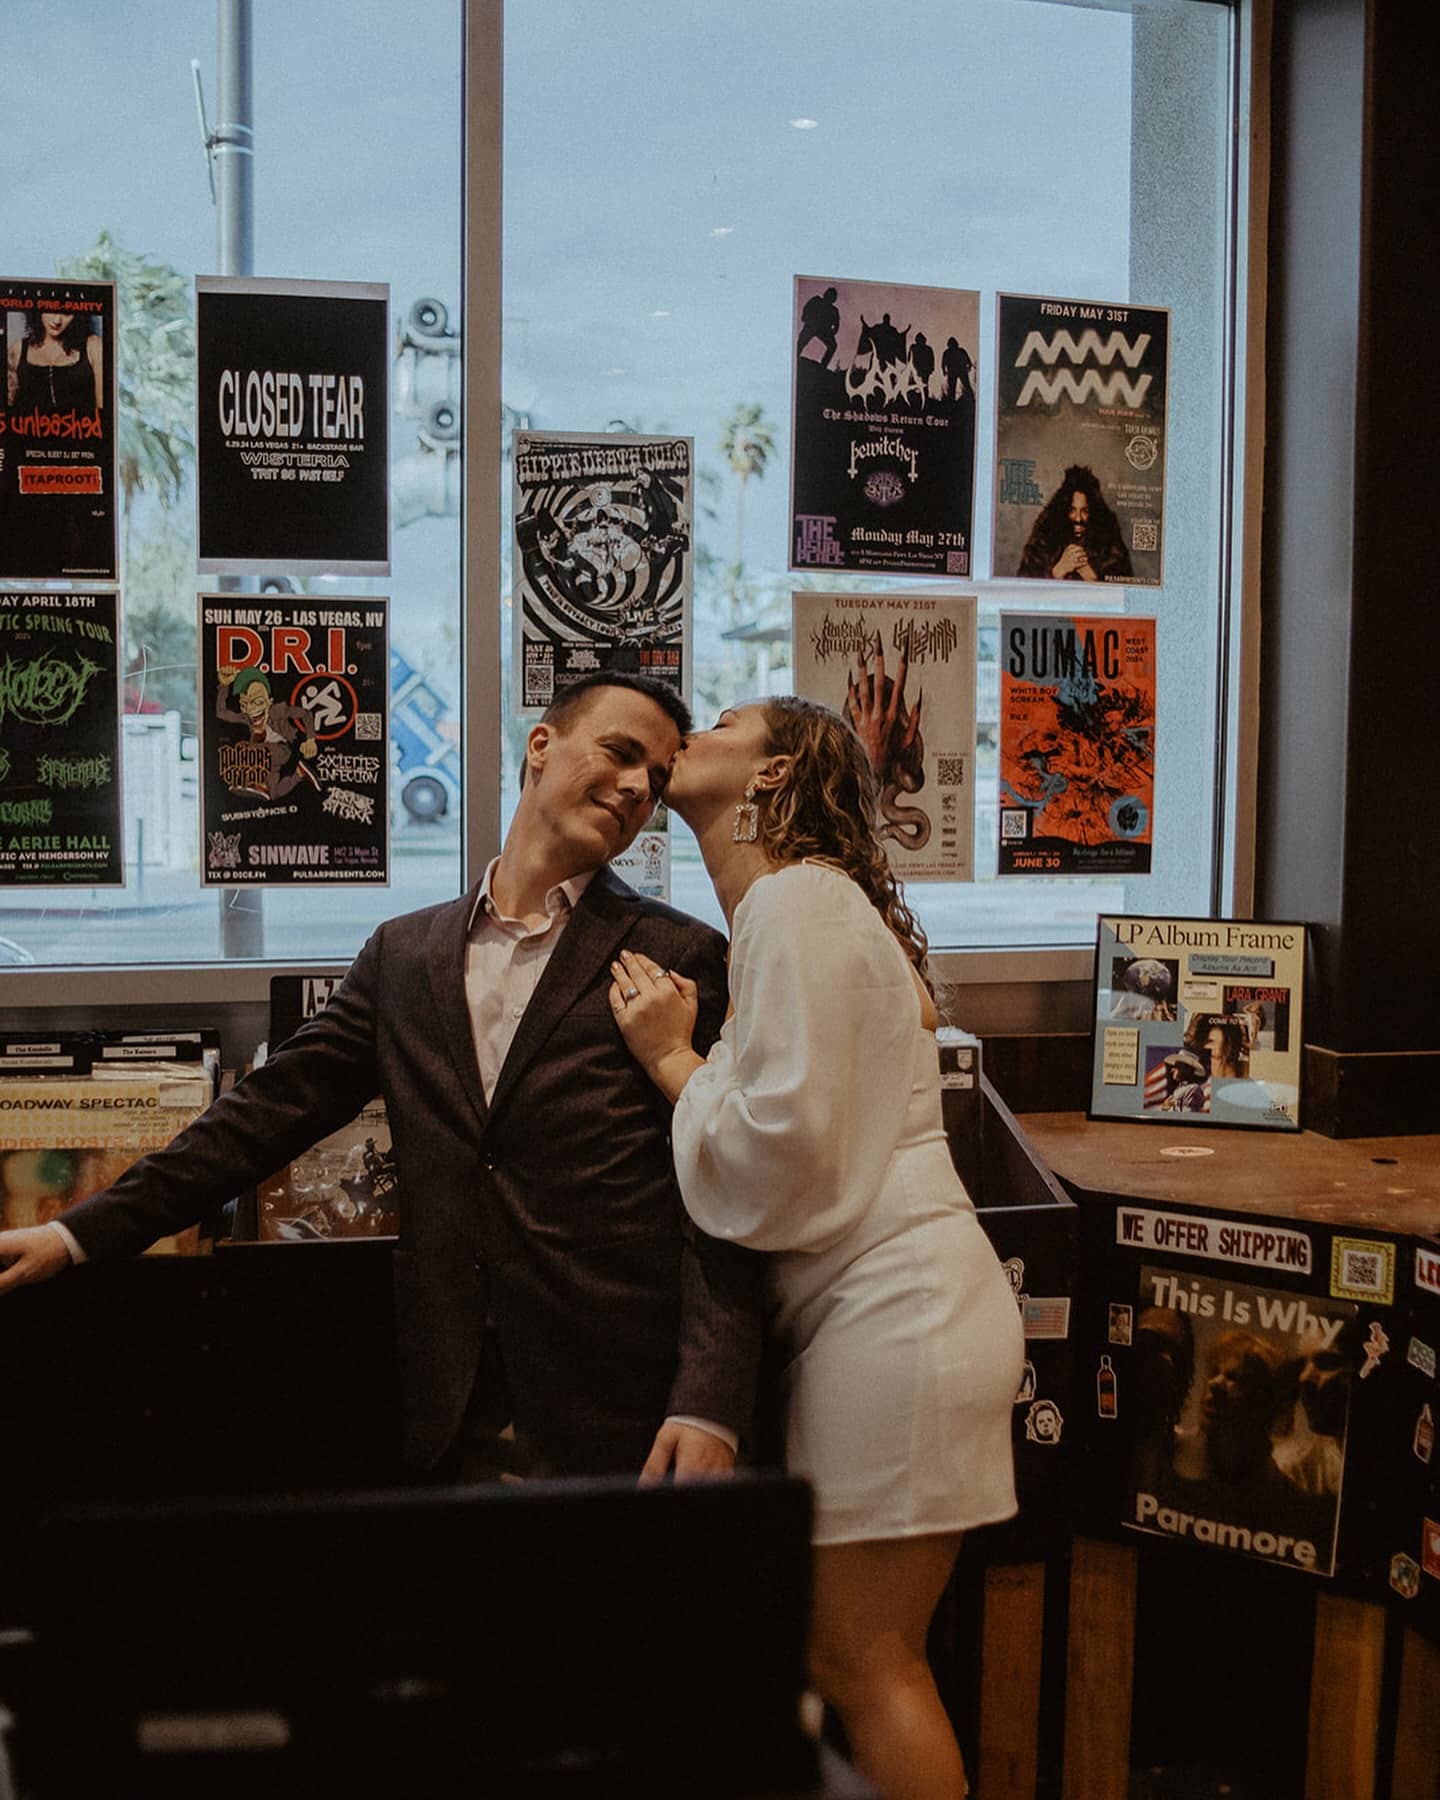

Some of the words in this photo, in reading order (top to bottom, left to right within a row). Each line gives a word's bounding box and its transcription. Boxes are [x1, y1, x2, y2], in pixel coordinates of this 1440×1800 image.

[0, 298, 33, 308] ORLD
[1040, 303, 1077, 319] FRIDAY
[1079, 306, 1104, 321] MAY
[1106, 309, 1129, 323] 31ST
[219, 369, 304, 437] CLOSED
[308, 374, 364, 440] TEAR
[823, 408, 841, 420] The
[843, 409, 888, 423] Shadows
[891, 411, 923, 426] Return
[250, 441, 264, 449] LAS
[265, 441, 289, 450] VEGAS
[240, 451, 350, 468] WISTERIA
[795, 514, 837, 541] THE
[851, 527, 903, 546] Monday
[905, 530, 934, 548] May
[937, 532, 965, 549] 27th
[0, 596, 20, 607] AY
[22, 596, 63, 608] APRIL
[835, 599, 884, 609] TUESDAY
[886, 601, 910, 610] MAY
[913, 601, 937, 610] 21ST
[204, 608, 232, 625] SUN
[234, 608, 263, 625] MAY
[264, 610, 282, 625] 26
[292, 610, 317, 626] LAS
[319, 611, 364, 628] VEGAS,
[365, 612, 384, 627] NV
[626, 609, 655, 623] LIVE
[25, 613, 73, 635] SPRING
[75, 619, 113, 644] TOUR
[216, 625, 358, 675] D.R.I.
[1009, 627, 1119, 680] SUMAC
[1125, 647, 1149, 655] COAST
[1010, 687, 1038, 695] WHITE
[1040, 687, 1058, 695] BOY
[317, 767, 379, 784] INFECTION
[9, 835, 62, 850] AERIE
[66, 835, 111, 850] HALL
[19, 852, 36, 860] AVE
[38, 851, 94, 861] HENDERSON
[248, 845, 330, 865] SINWAVE
[1012, 857, 1043, 869] JUNE
[1045, 858, 1061, 869] 30
[208, 871, 222, 879] TIX
[232, 871, 267, 880] DICE.FM
[293, 870, 385, 880] PULSARPRESENTS.COM
[1114, 923, 1144, 944] LP
[1147, 924, 1220, 948] Album
[1225, 926, 1296, 950] Frame
[1226, 987, 1251, 1002] LARA
[1255, 988, 1289, 1005] GRANT
[1122, 1212, 1145, 1242] WE
[1154, 1216, 1209, 1252] OFFER
[1219, 1227, 1308, 1268] SHIPPING
[1151, 1275, 1216, 1317] This
[1223, 1289, 1251, 1324] Is
[1256, 1295, 1345, 1350] Why
[1135, 1492, 1317, 1563] Paramore
